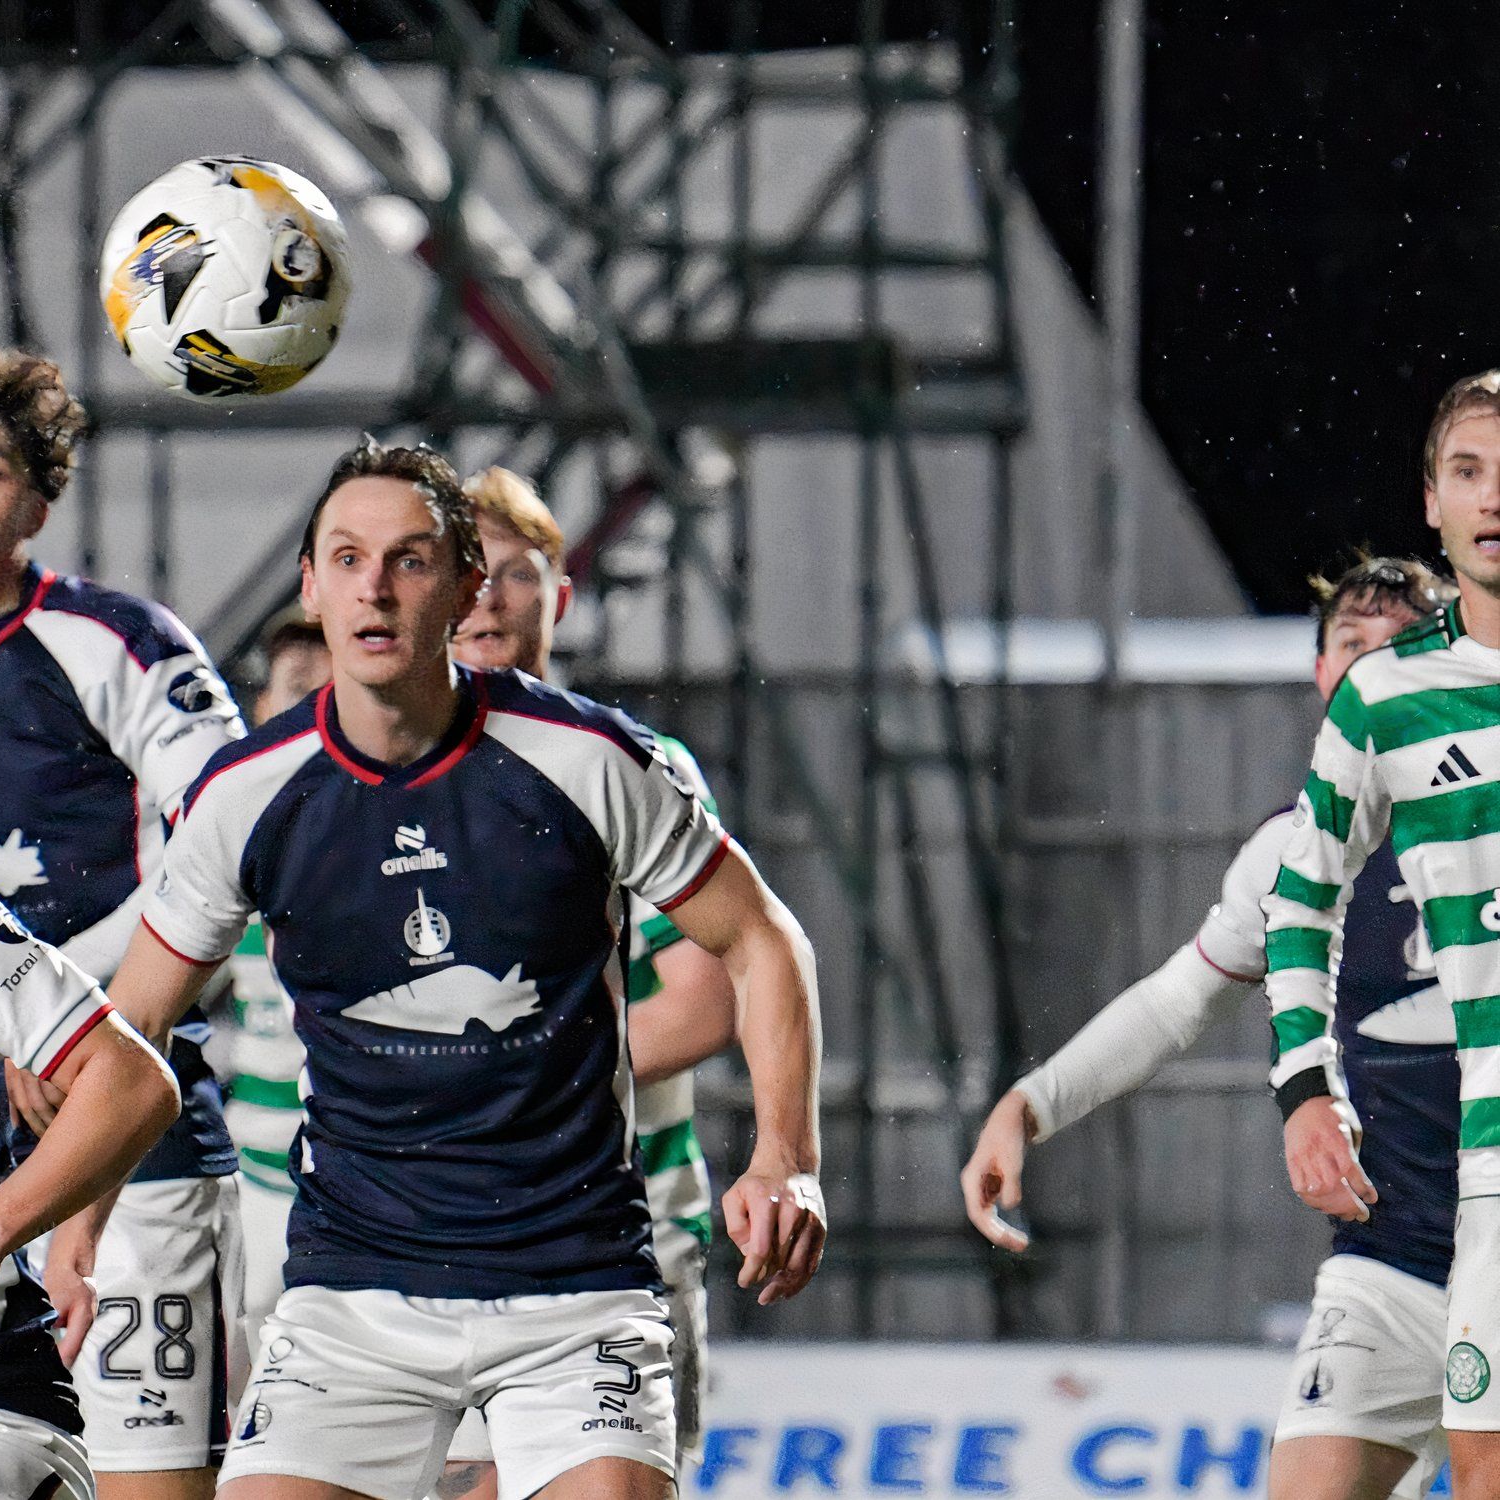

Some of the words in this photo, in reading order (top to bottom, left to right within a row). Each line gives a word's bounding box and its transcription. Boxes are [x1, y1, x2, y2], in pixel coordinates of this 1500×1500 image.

[0, 952, 39, 993] Total
[97, 1293, 196, 1380] 28
[592, 1336, 645, 1396] 5
[696, 1422, 1024, 1494] FREE
